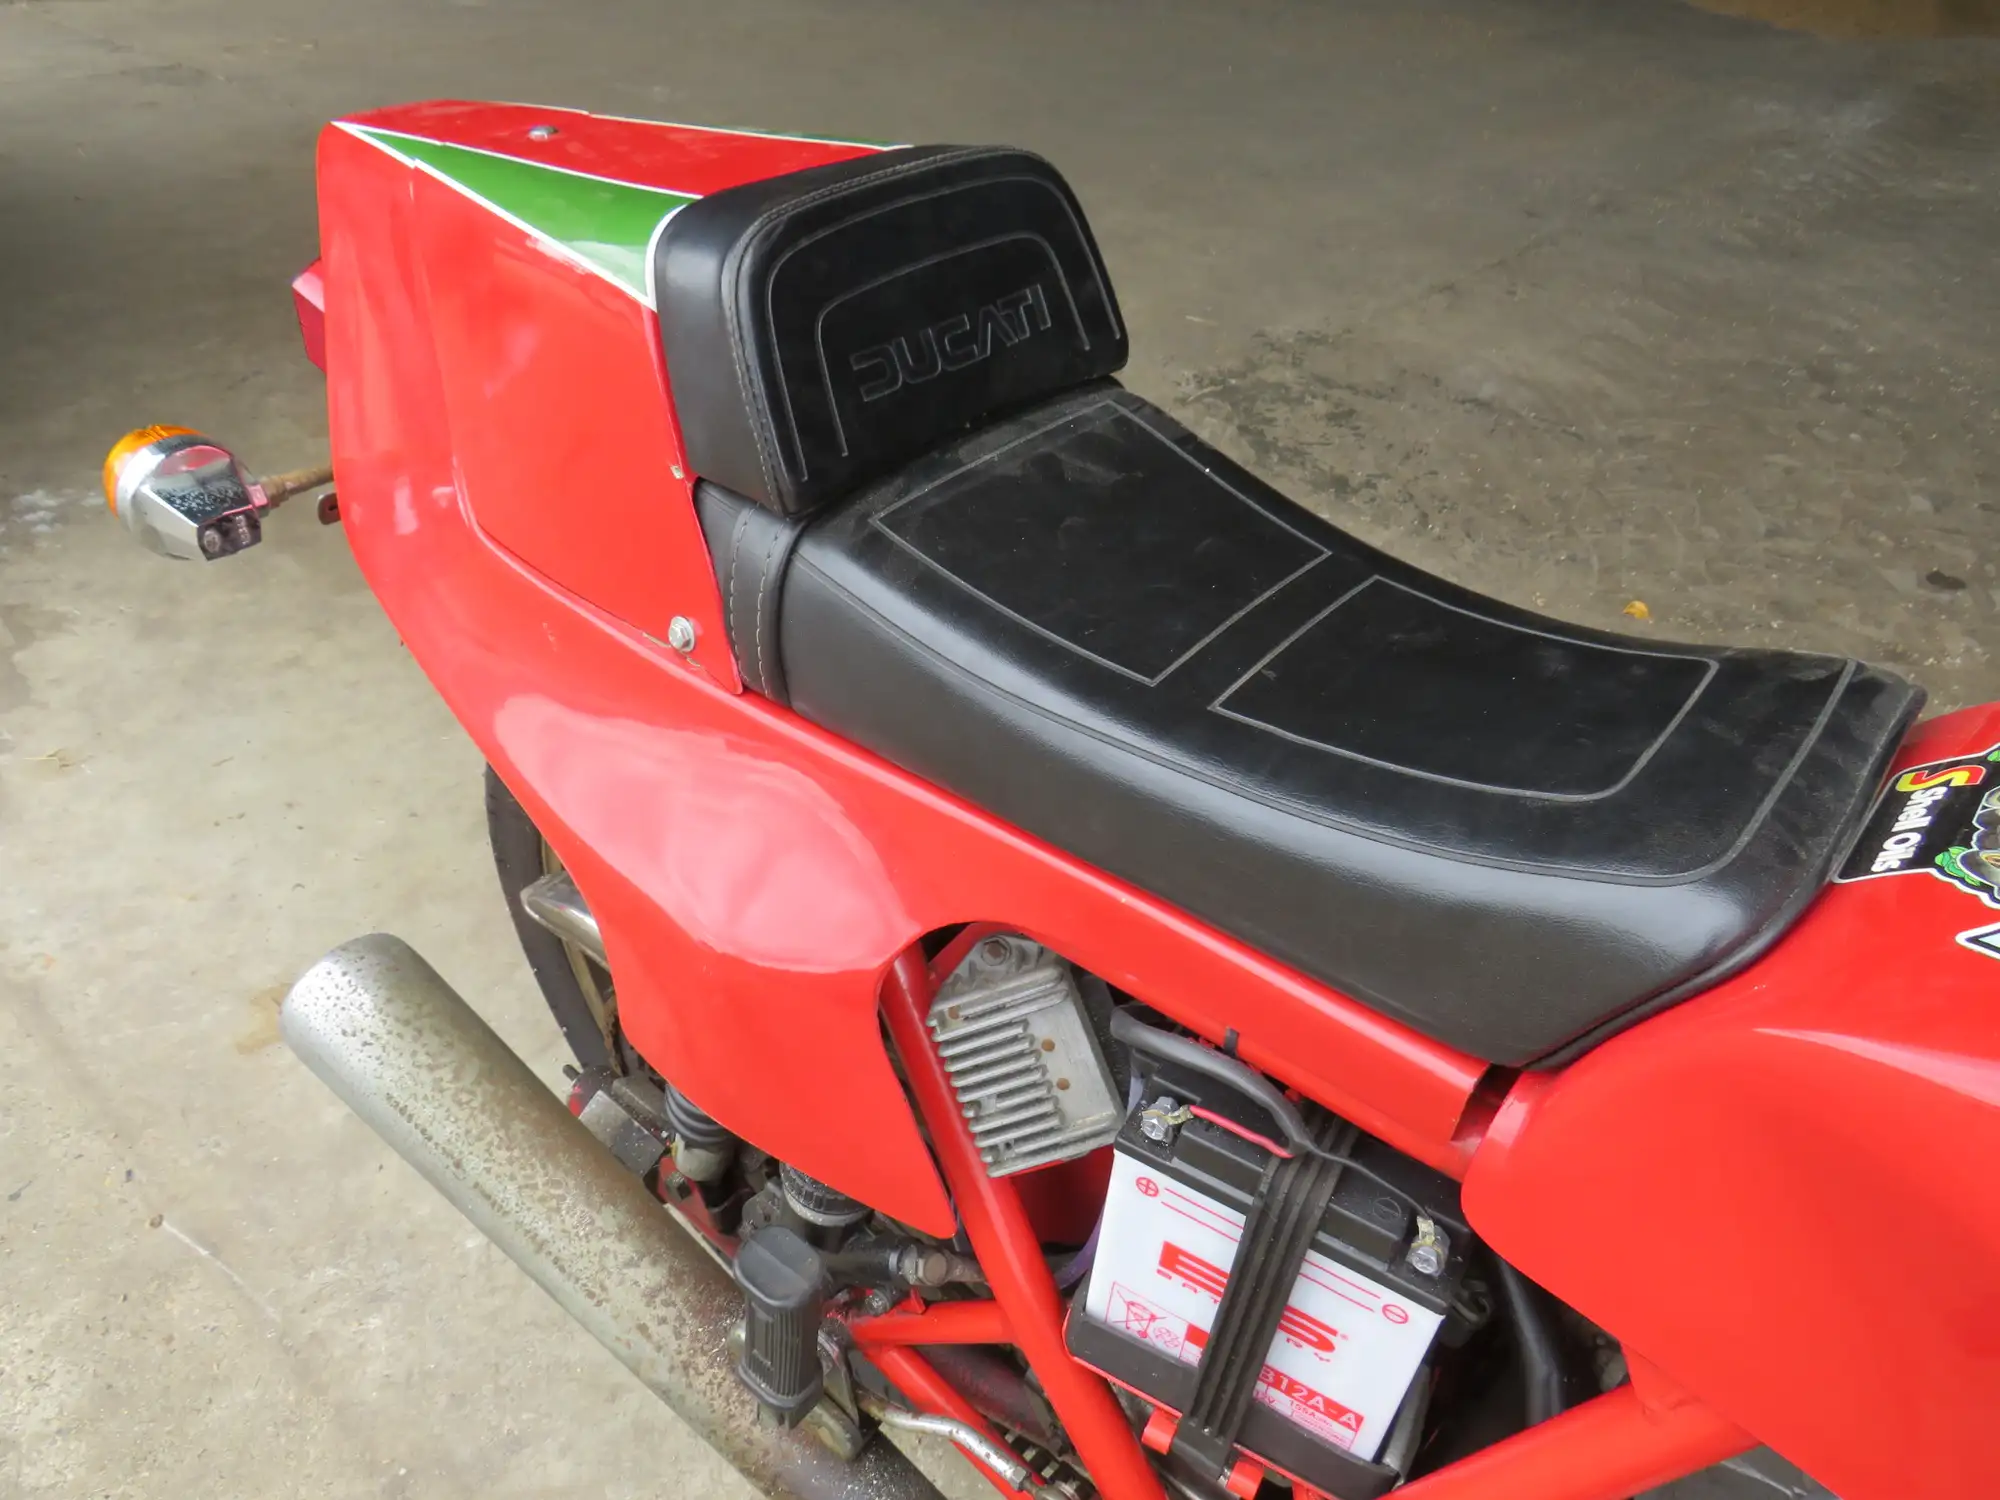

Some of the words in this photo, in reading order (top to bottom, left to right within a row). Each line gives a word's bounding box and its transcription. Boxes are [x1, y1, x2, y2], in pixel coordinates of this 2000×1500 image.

[850, 283, 1051, 402] DUCATI
[1891, 786, 1948, 832] Shell
[1870, 832, 1922, 872] Oils
